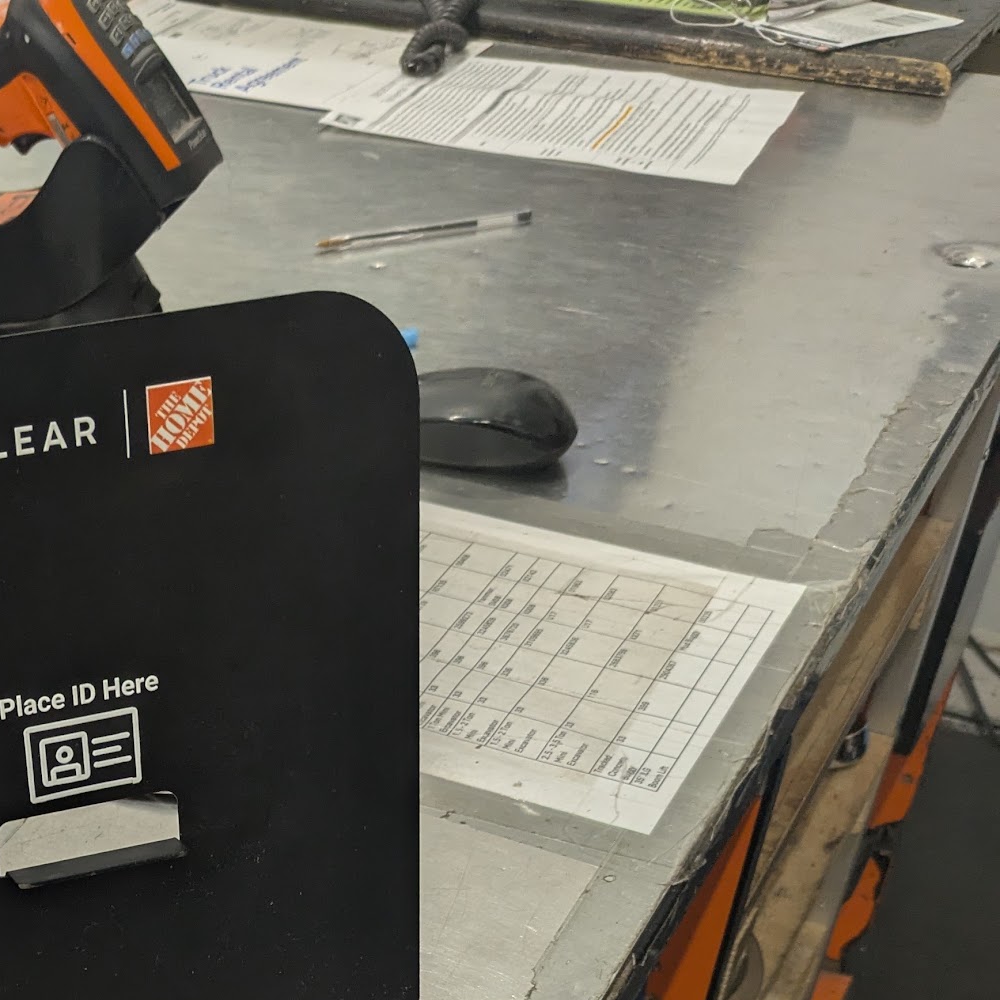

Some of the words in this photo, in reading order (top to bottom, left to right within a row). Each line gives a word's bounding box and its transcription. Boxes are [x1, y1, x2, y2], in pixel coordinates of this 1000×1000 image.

[151, 379, 213, 453] HOME
[154, 390, 182, 420] THE
[175, 403, 213, 450] DEPOT
[71, 682, 96, 707] ID
[102, 674, 159, 701] Here
